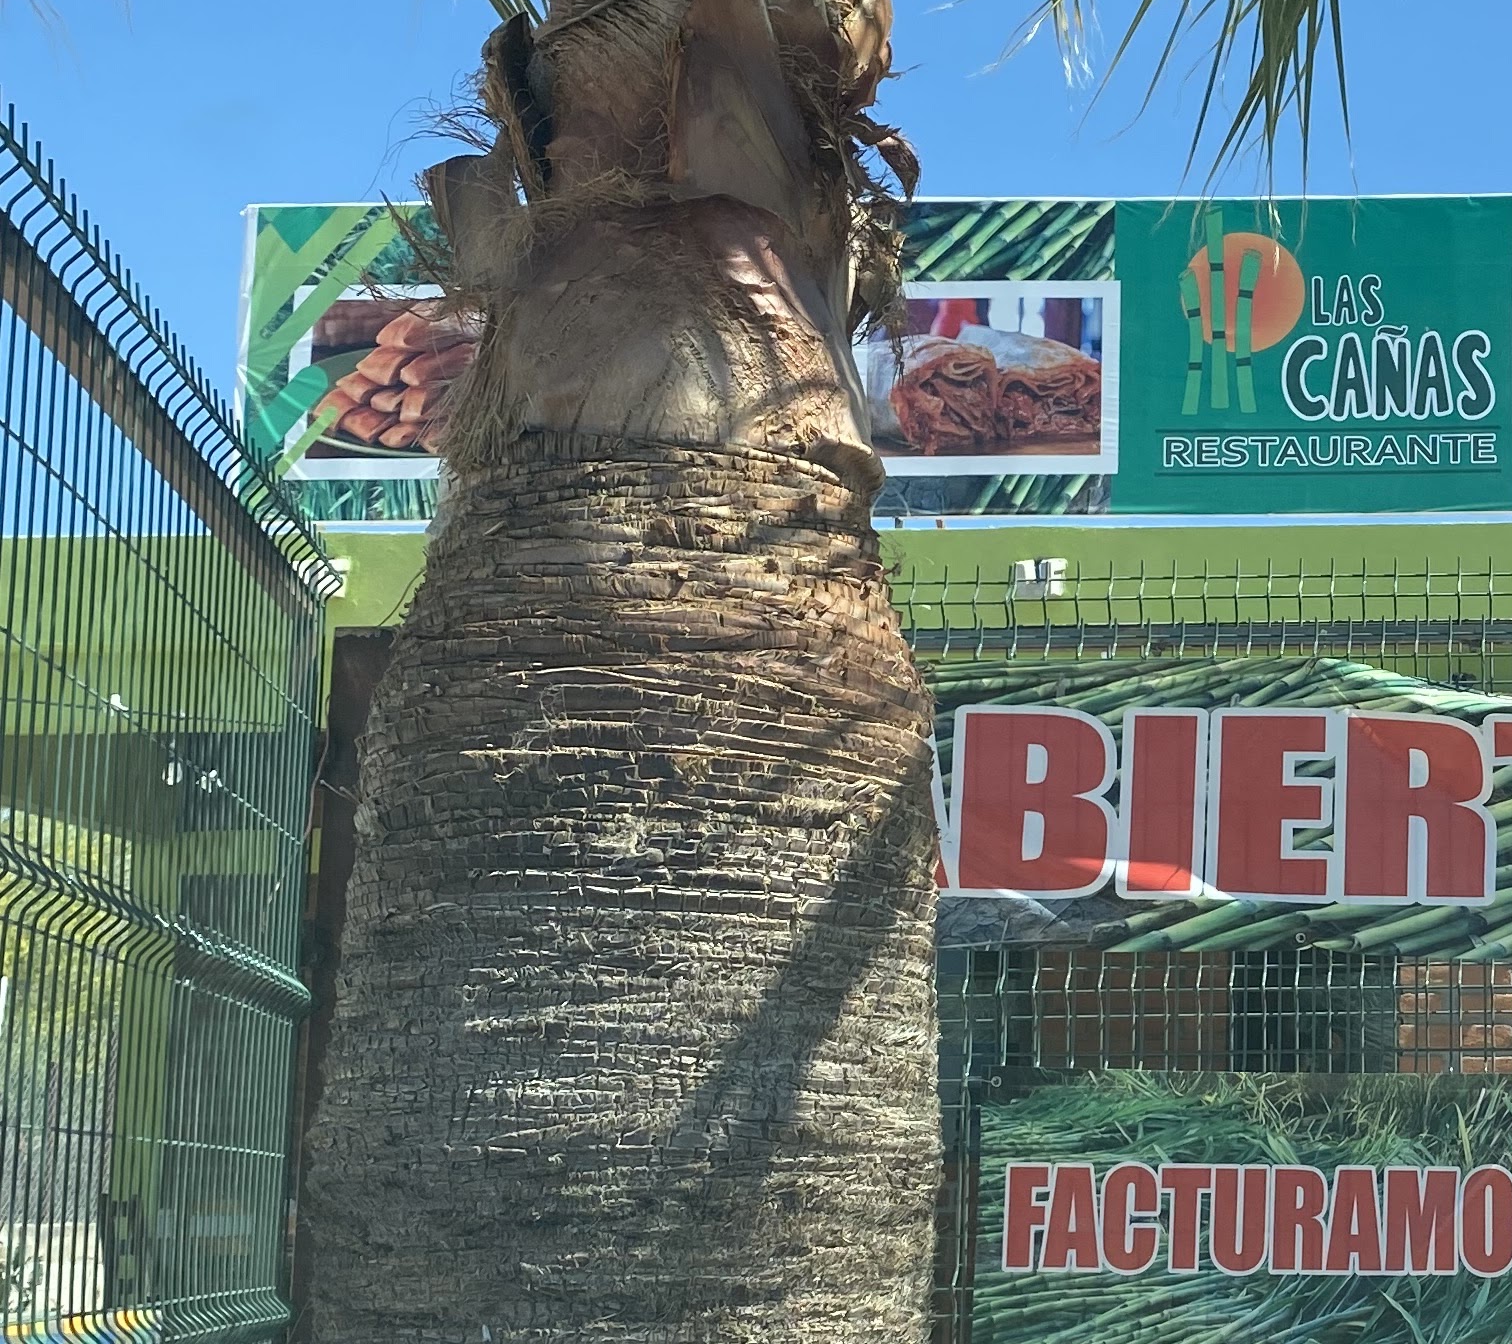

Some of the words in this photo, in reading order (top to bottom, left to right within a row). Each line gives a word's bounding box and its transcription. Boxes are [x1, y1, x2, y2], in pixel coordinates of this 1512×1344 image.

[1311, 273, 1384, 327] LAS
[1280, 325, 1496, 421] CAÑAS
[1162, 432, 1497, 468] RESTAURANTE
